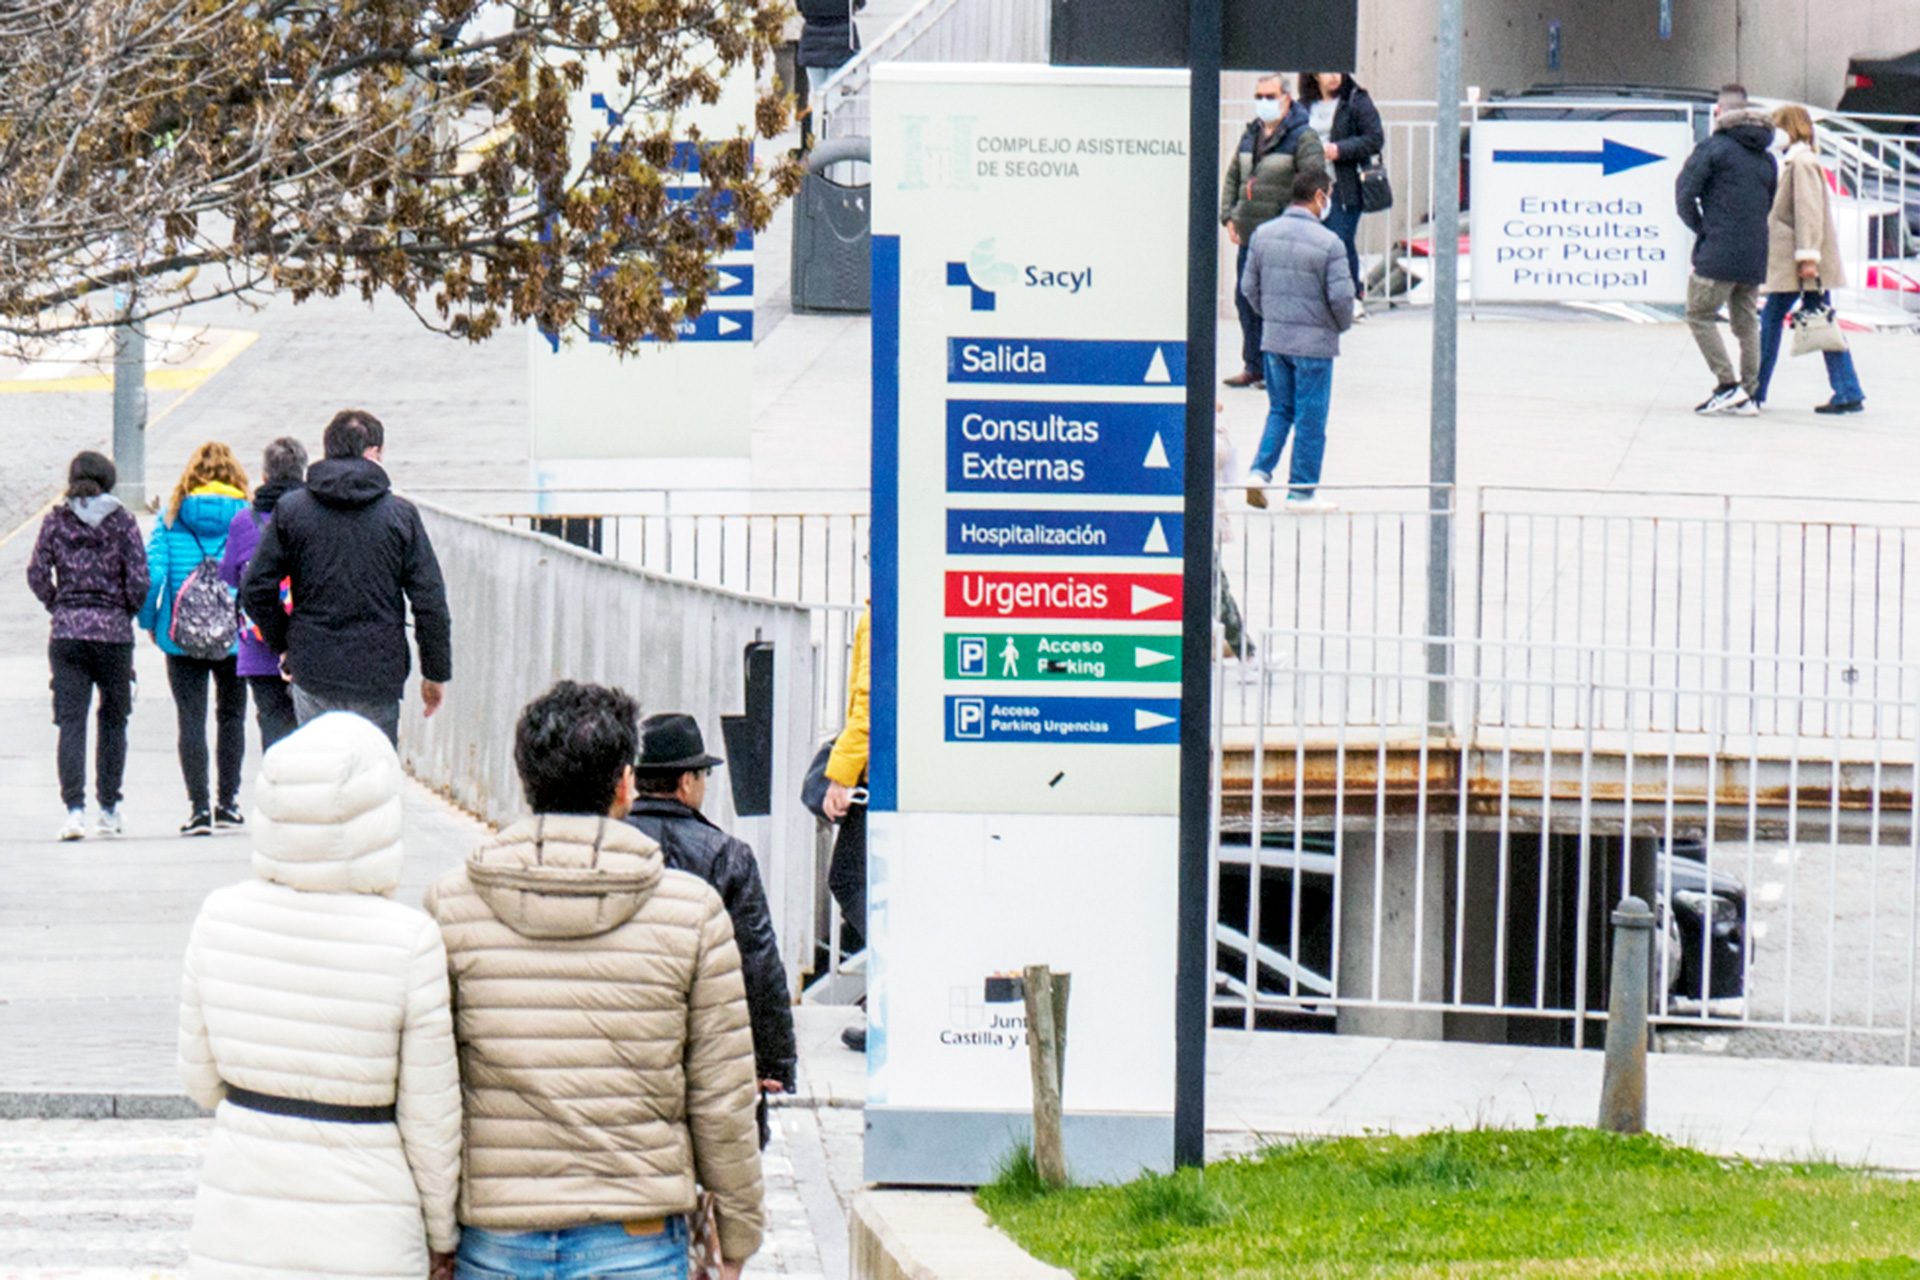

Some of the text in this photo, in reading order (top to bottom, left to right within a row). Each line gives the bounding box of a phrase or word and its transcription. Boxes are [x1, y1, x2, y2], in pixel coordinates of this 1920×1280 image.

[977, 136, 1187, 156] COMPLEJO ASISTENCIAL
[977, 161, 1080, 178] DE SEGOVIA
[1520, 197, 1643, 215] Entrada
[1503, 221, 1659, 238] Consultas
[1497, 243, 1666, 263] por Puerta
[1025, 265, 1092, 293] Sacyl
[1514, 268, 1647, 289] Principal
[962, 344, 1047, 373] Salida
[962, 413, 1099, 443] Consultas
[962, 452, 1085, 482] Externas
[961, 523, 1106, 548] Hospitalización
[962, 575, 1108, 614] Urgencias
[1037, 637, 1104, 654] Acceso
[962, 643, 983, 670] P
[960, 706, 981, 732] P
[991, 704, 1040, 717] Acceso
[991, 720, 1109, 735] Parking Urgencias
[940, 1030, 1003, 1045] Castilla
[1008, 1034, 1019, 1049] y
